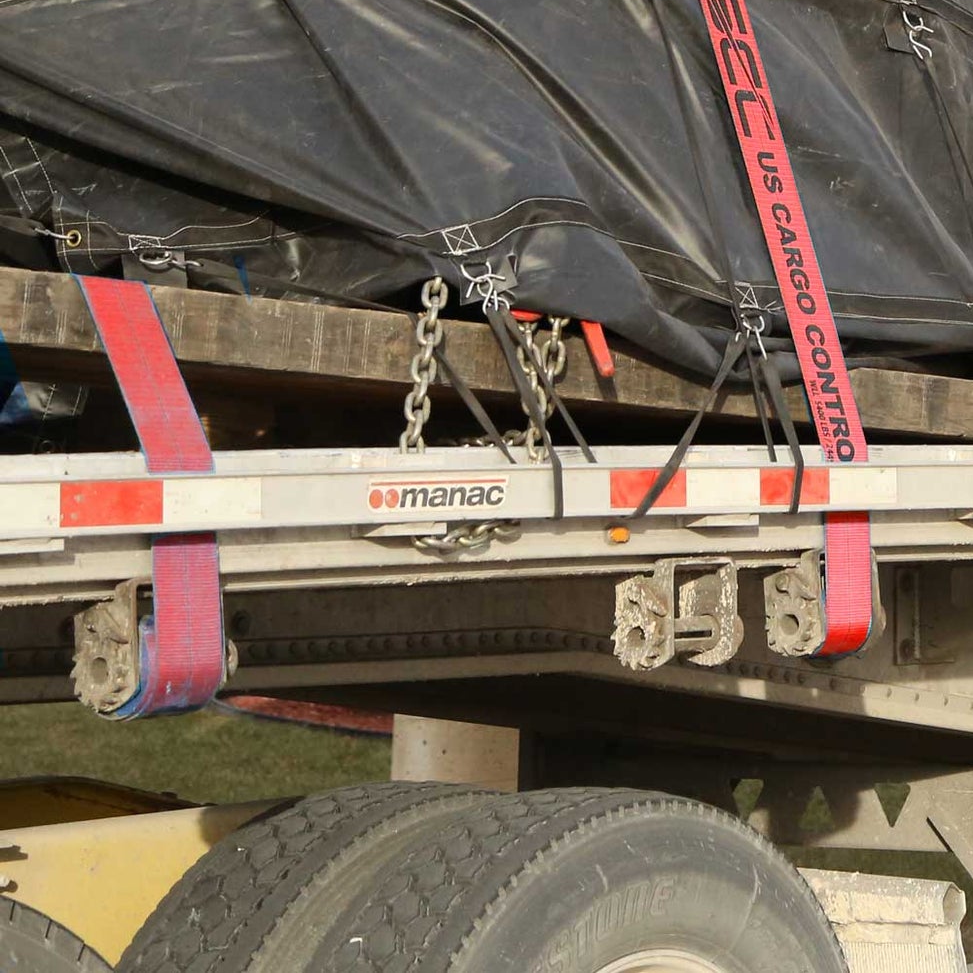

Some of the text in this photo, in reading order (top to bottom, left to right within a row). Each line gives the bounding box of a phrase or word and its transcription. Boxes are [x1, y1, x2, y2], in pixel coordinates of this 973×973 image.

[757, 151, 783, 195] US
[771, 203, 817, 316] CARGO
[805, 324, 855, 462] CONTRO
[400, 485, 504, 508] manac
[531, 874, 677, 973] STONE
